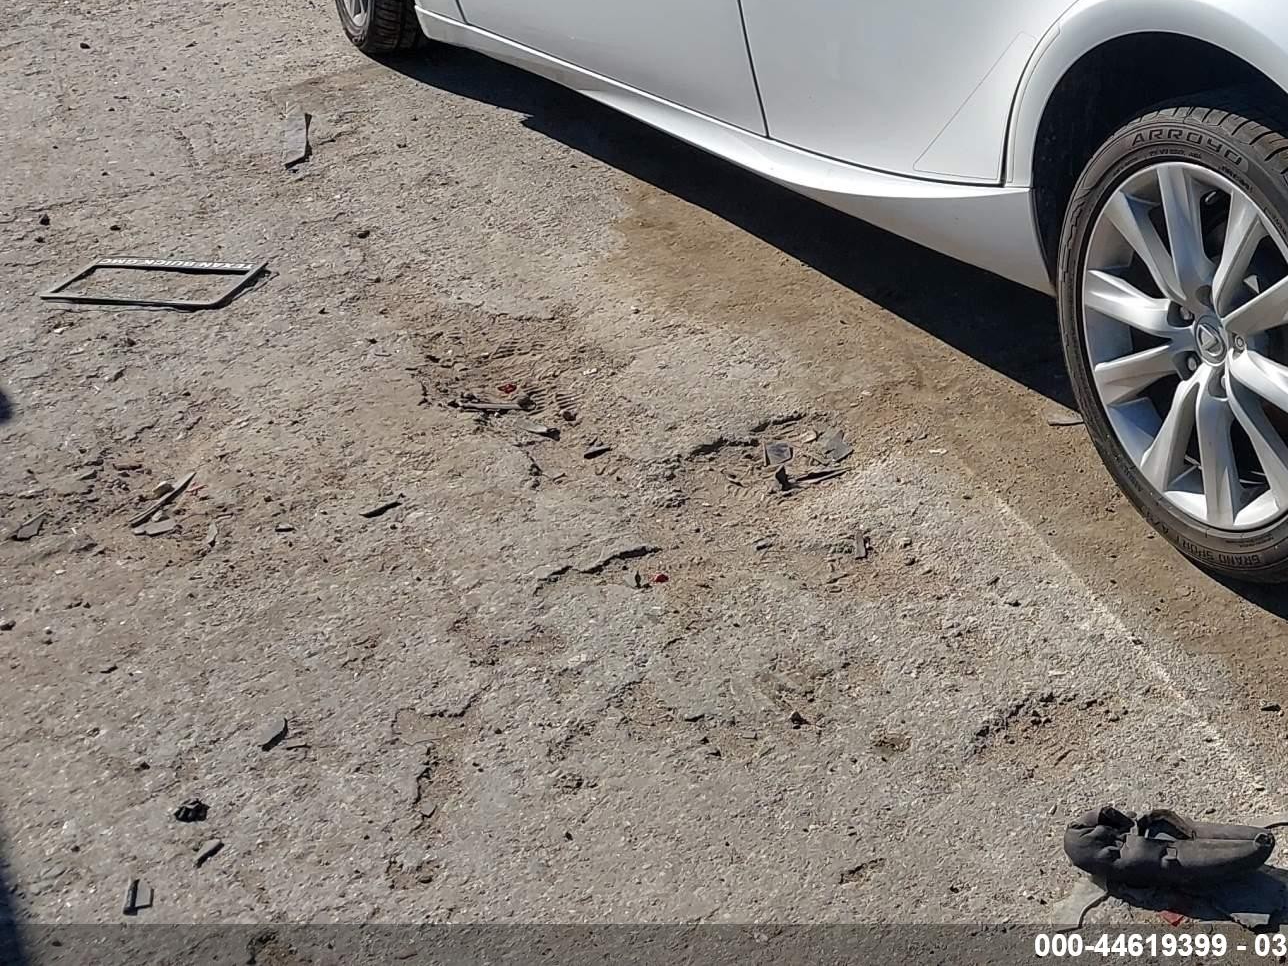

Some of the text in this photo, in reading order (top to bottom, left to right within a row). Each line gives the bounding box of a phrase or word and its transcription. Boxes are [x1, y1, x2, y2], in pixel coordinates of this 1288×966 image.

[1131, 128, 1243, 166] ARROYO
[144, 259, 197, 268] BUICK
[201, 261, 254, 270] TEXAN
[1218, 553, 1261, 567] GRAND
